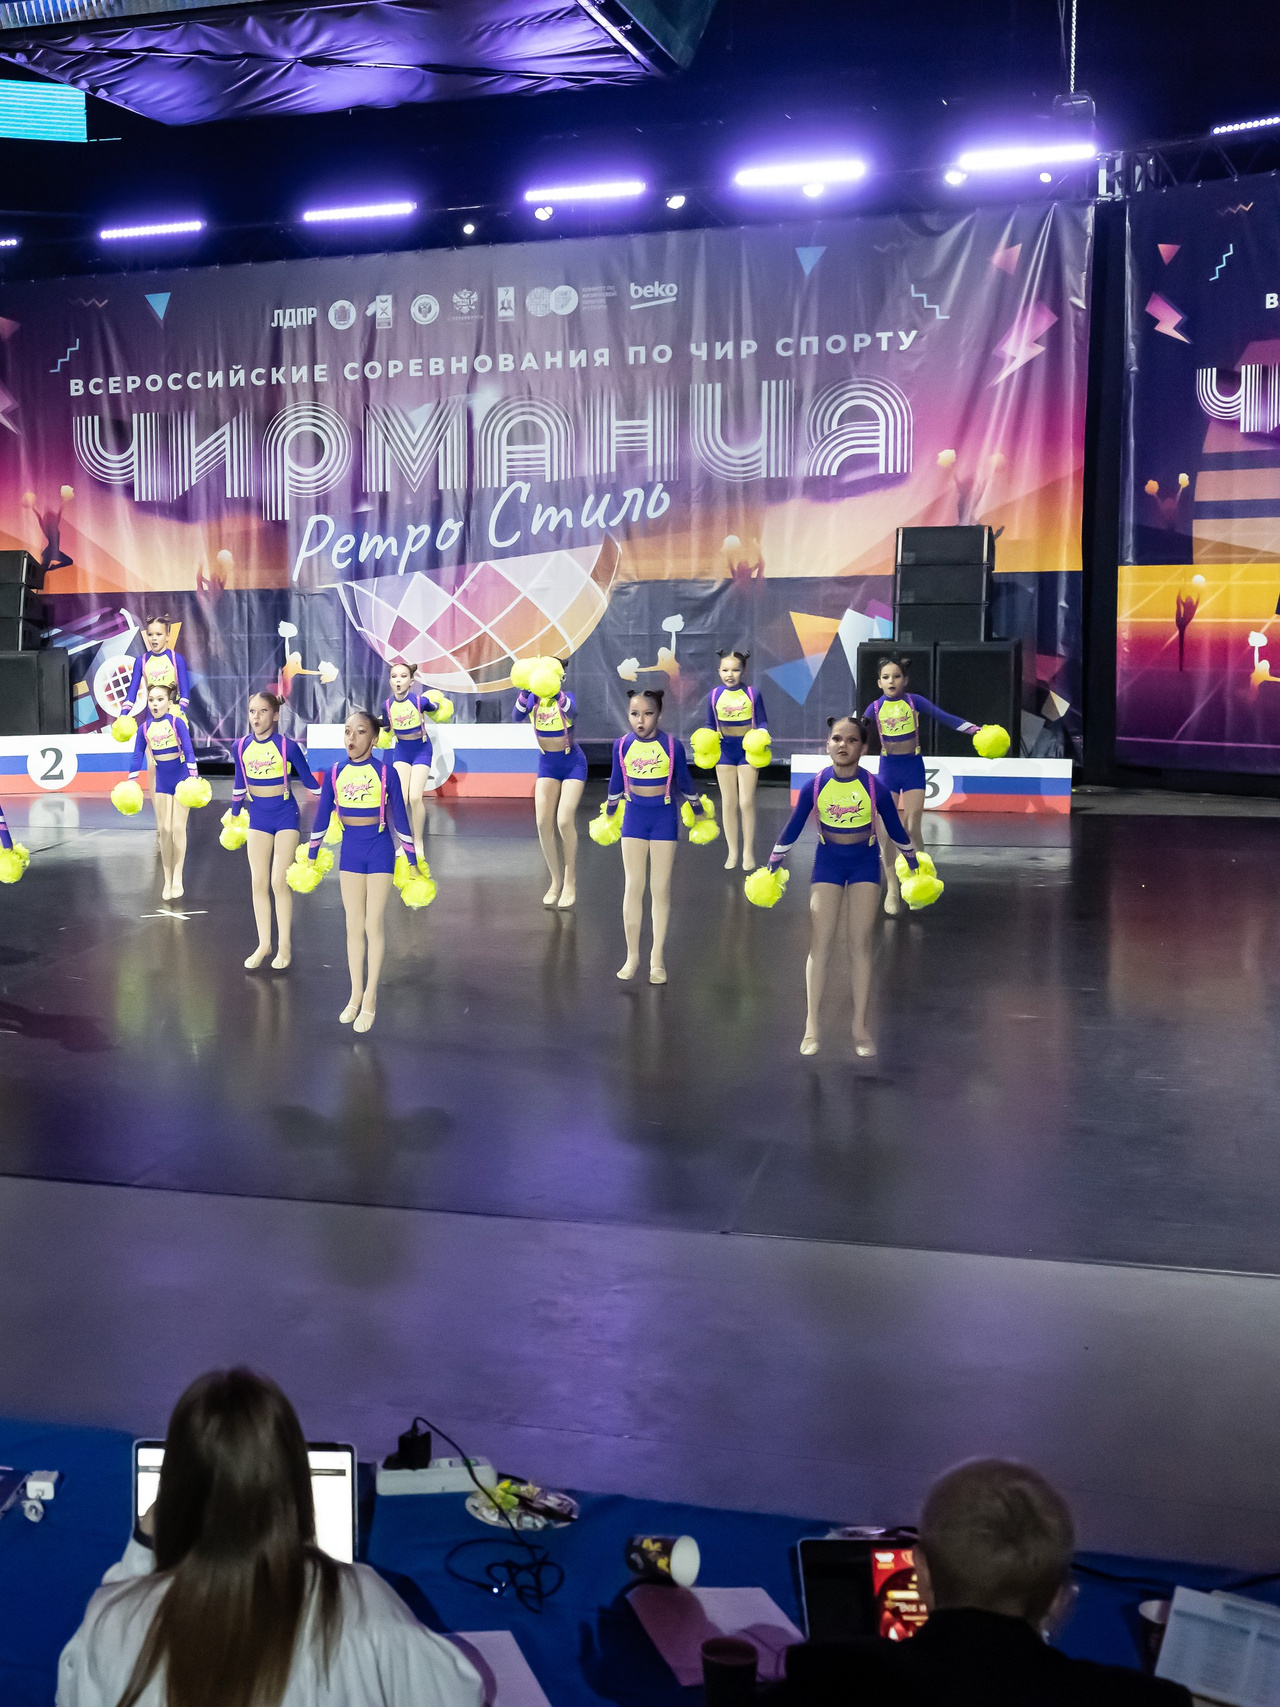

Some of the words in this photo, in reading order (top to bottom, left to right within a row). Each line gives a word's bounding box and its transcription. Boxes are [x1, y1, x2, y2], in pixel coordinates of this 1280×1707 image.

[630, 282, 678, 298] beko
[271, 307, 317, 329] ЛДПР
[69, 364, 329, 396] ВСЕРОССИЙСКИЕ
[343, 349, 610, 381] СОРЕВНОВАНИЯ
[628, 344, 673, 365] ПО
[690, 340, 758, 361] ЧИР
[775, 330, 918, 357] СПОРТУ
[291, 513, 463, 581] Ретро
[487, 482, 671, 547] Стиль
[40, 747, 65, 780] 2
